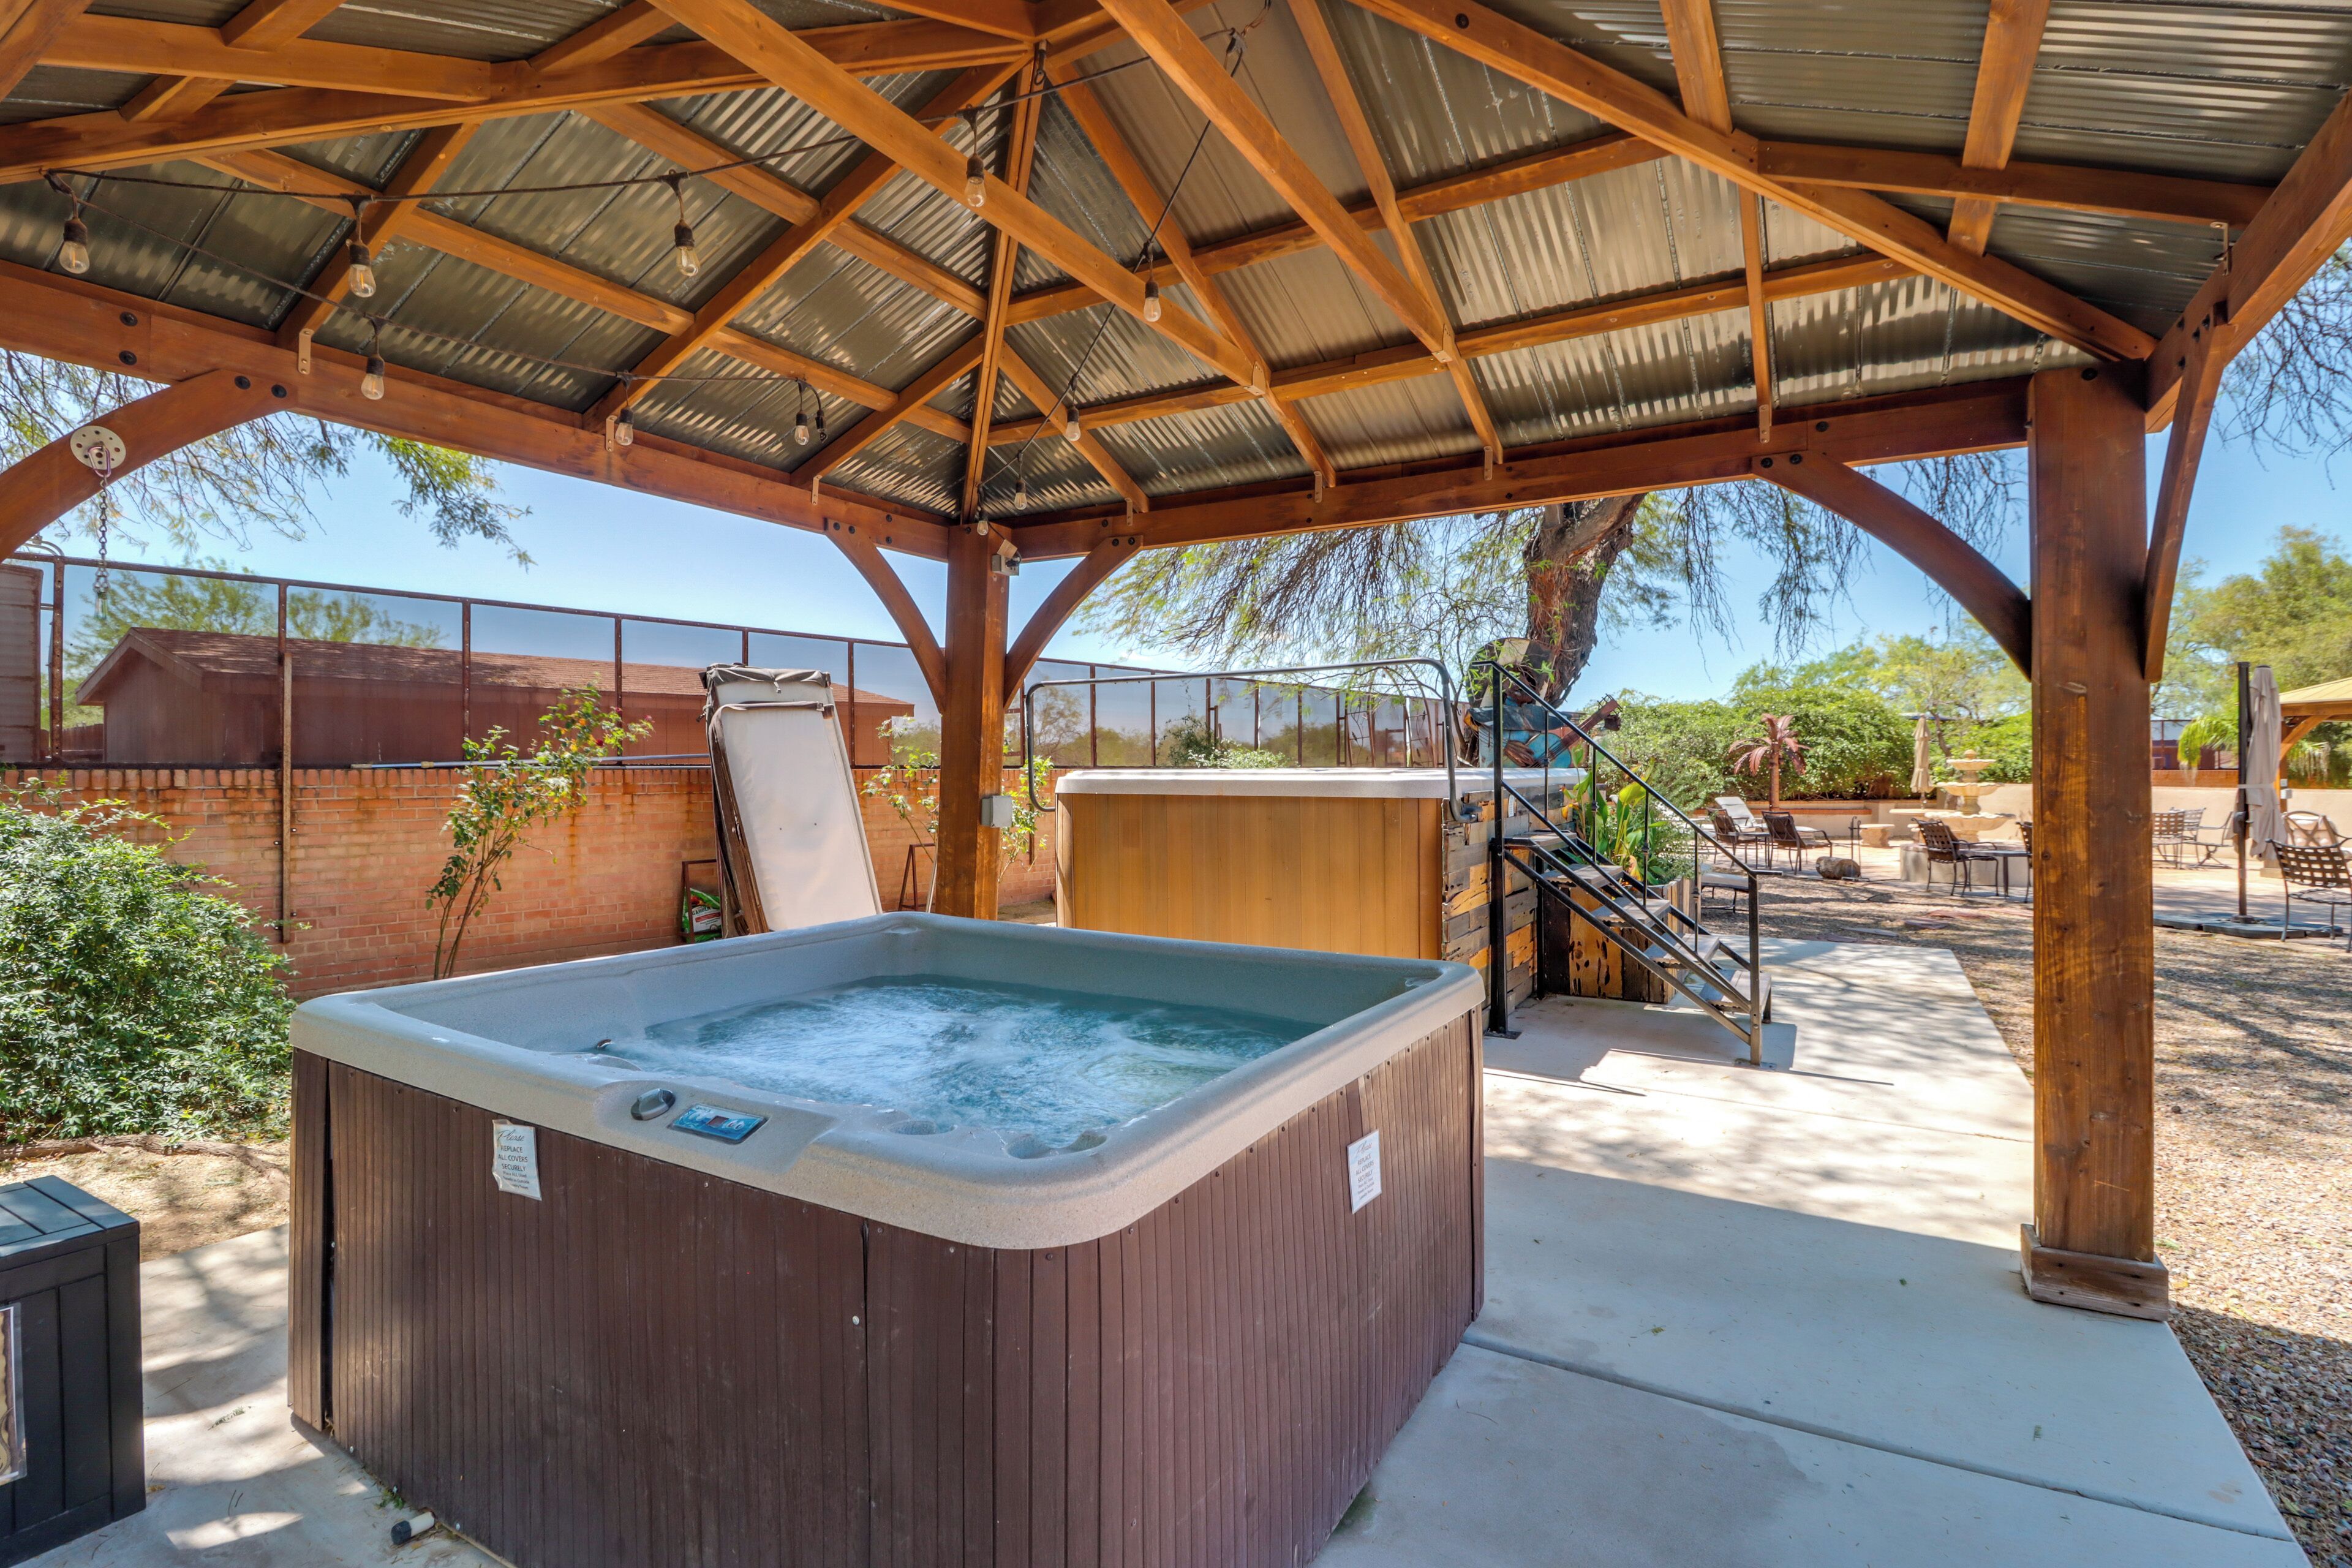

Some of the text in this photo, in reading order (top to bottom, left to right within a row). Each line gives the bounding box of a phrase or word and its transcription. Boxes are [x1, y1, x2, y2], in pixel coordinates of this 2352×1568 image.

[692, 907, 711, 915] GARDEN
[497, 1129, 525, 1141] Please
[1355, 1140, 1372, 1158] Please
[1358, 1153, 1371, 1165] REPLACE
[1362, 1160, 1374, 1172] COVERS
[1357, 1170, 1373, 1183] SECURELY
